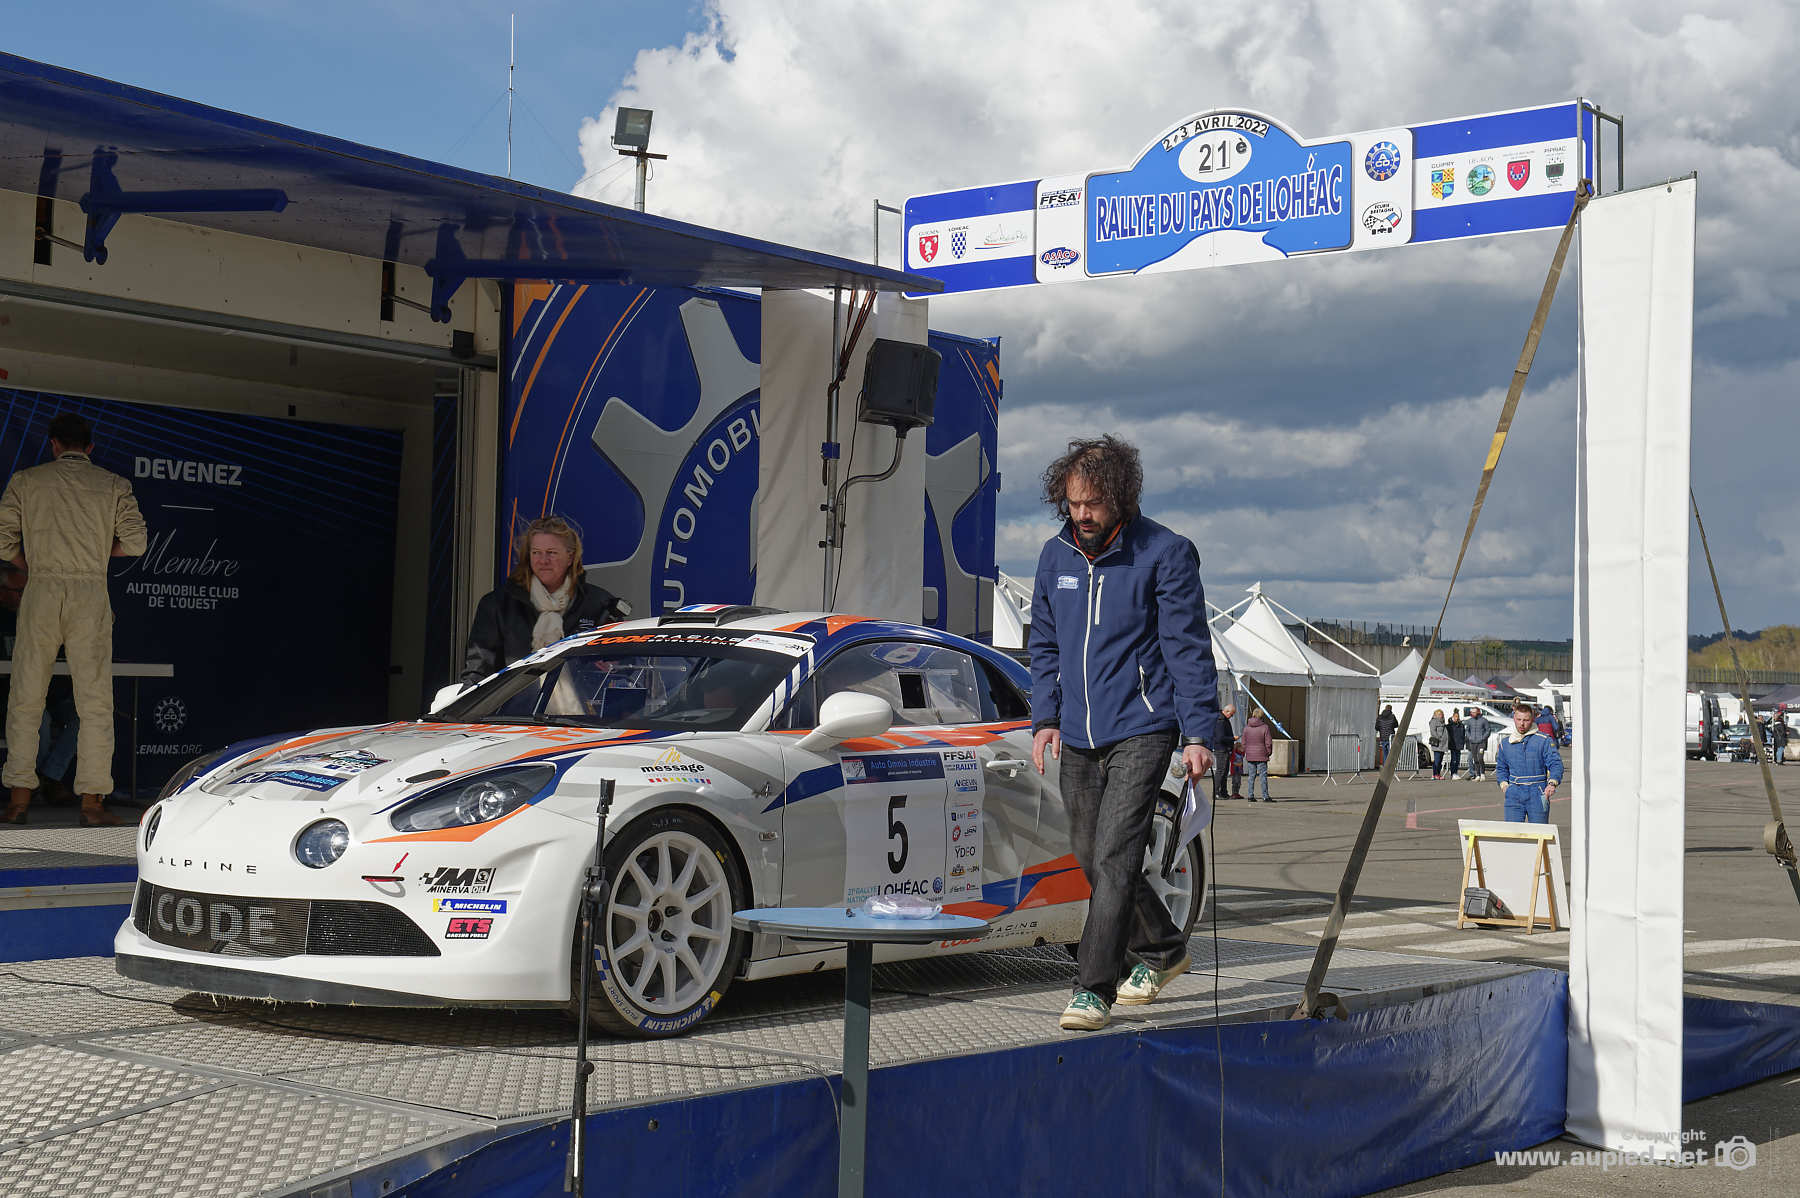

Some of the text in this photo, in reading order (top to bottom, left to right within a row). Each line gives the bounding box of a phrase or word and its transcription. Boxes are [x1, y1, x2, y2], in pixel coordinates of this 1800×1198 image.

[1194, 116, 1233, 132] AVRIL
[1236, 116, 1268, 136] 2022
[1040, 192, 1077, 205] FFSA
[1096, 152, 1343, 242] RALLYE DU PAYS DE LOHÉAC
[134, 456, 243, 487] DEVENEZ
[114, 528, 240, 577] Membre
[126, 582, 239, 599] AUTOMOBILE CLUB
[148, 596, 218, 610] DE L'OUEST
[943, 752, 974, 761] FFSA
[641, 763, 705, 773] message
[888, 795, 908, 874] 5
[158, 856, 257, 875] ALPINE
[427, 886, 469, 894] MINERVA
[453, 902, 502, 911] MICHELIN
[157, 893, 276, 945] CODE
[449, 918, 492, 933] ETS
[645, 1007, 702, 1031] MICHELIN
